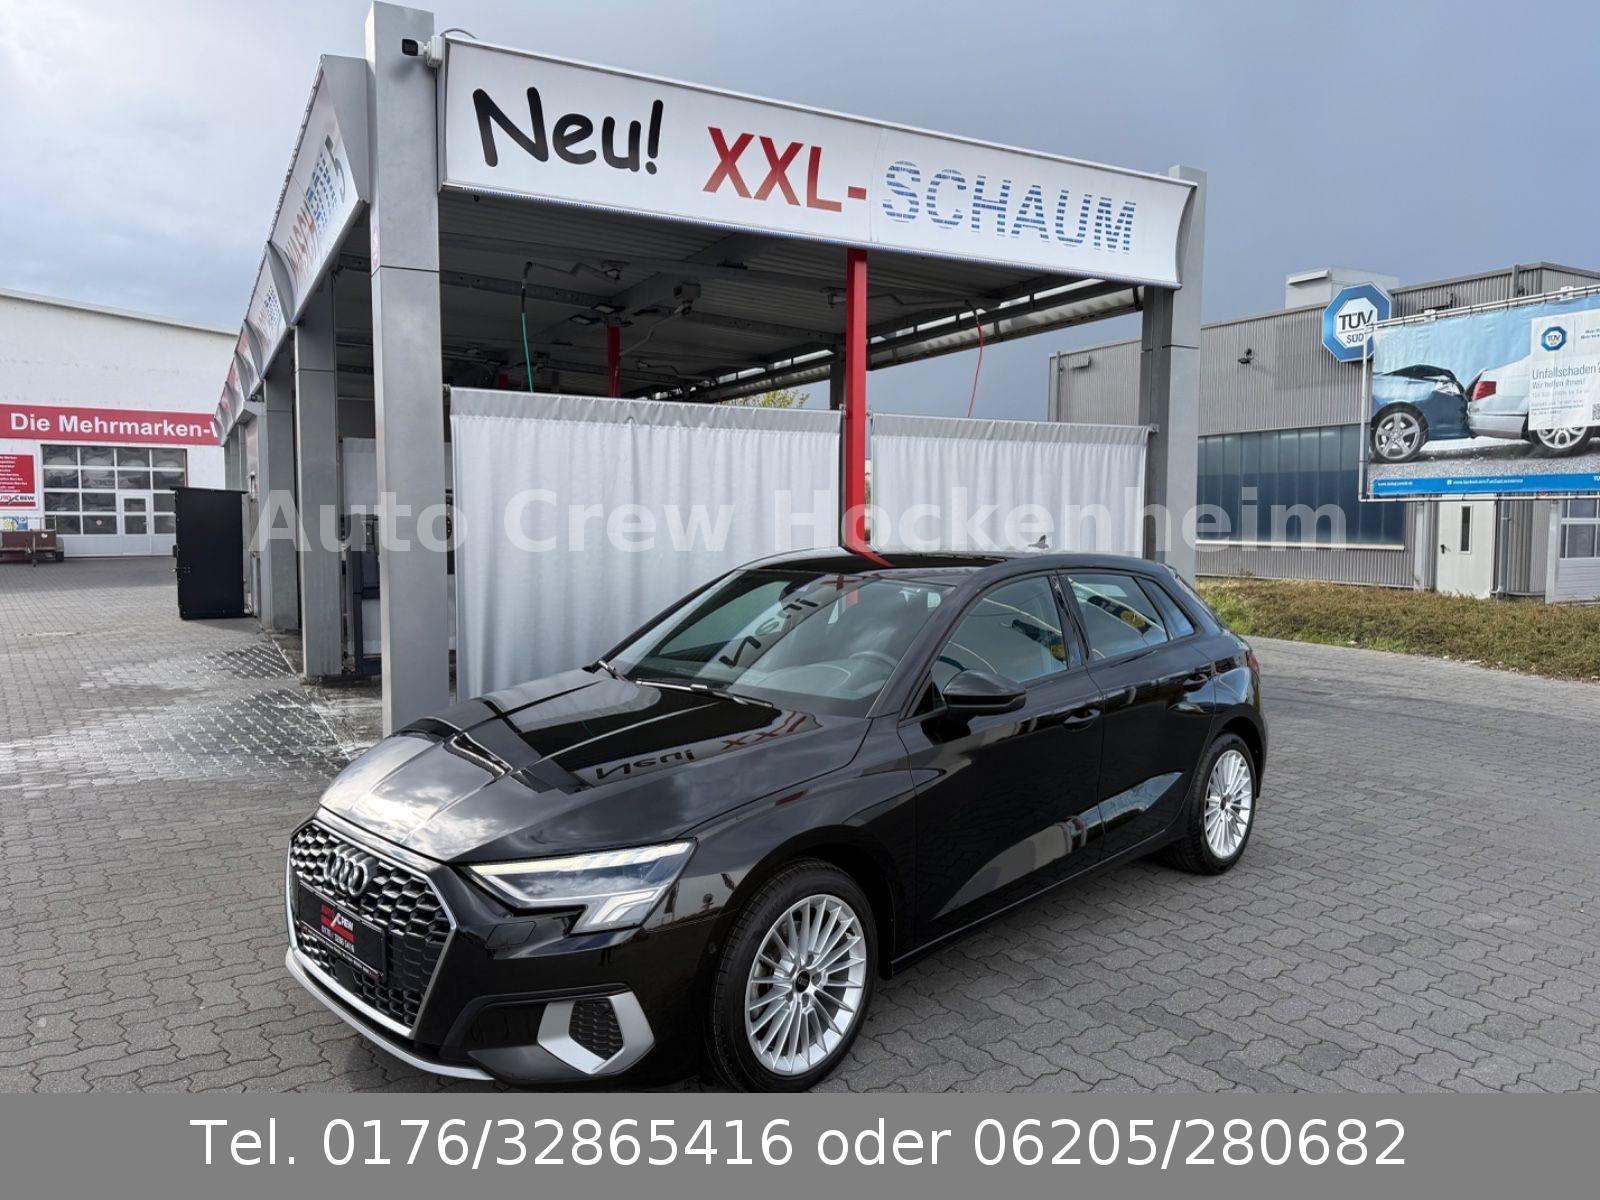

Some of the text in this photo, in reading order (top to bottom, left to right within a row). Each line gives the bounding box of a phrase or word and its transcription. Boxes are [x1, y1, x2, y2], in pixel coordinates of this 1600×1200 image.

[472, 86, 664, 176] Neu!
[1338, 309, 1374, 331] TÜV
[1346, 333, 1364, 344] SÜD
[10, 413, 50, 431] Die
